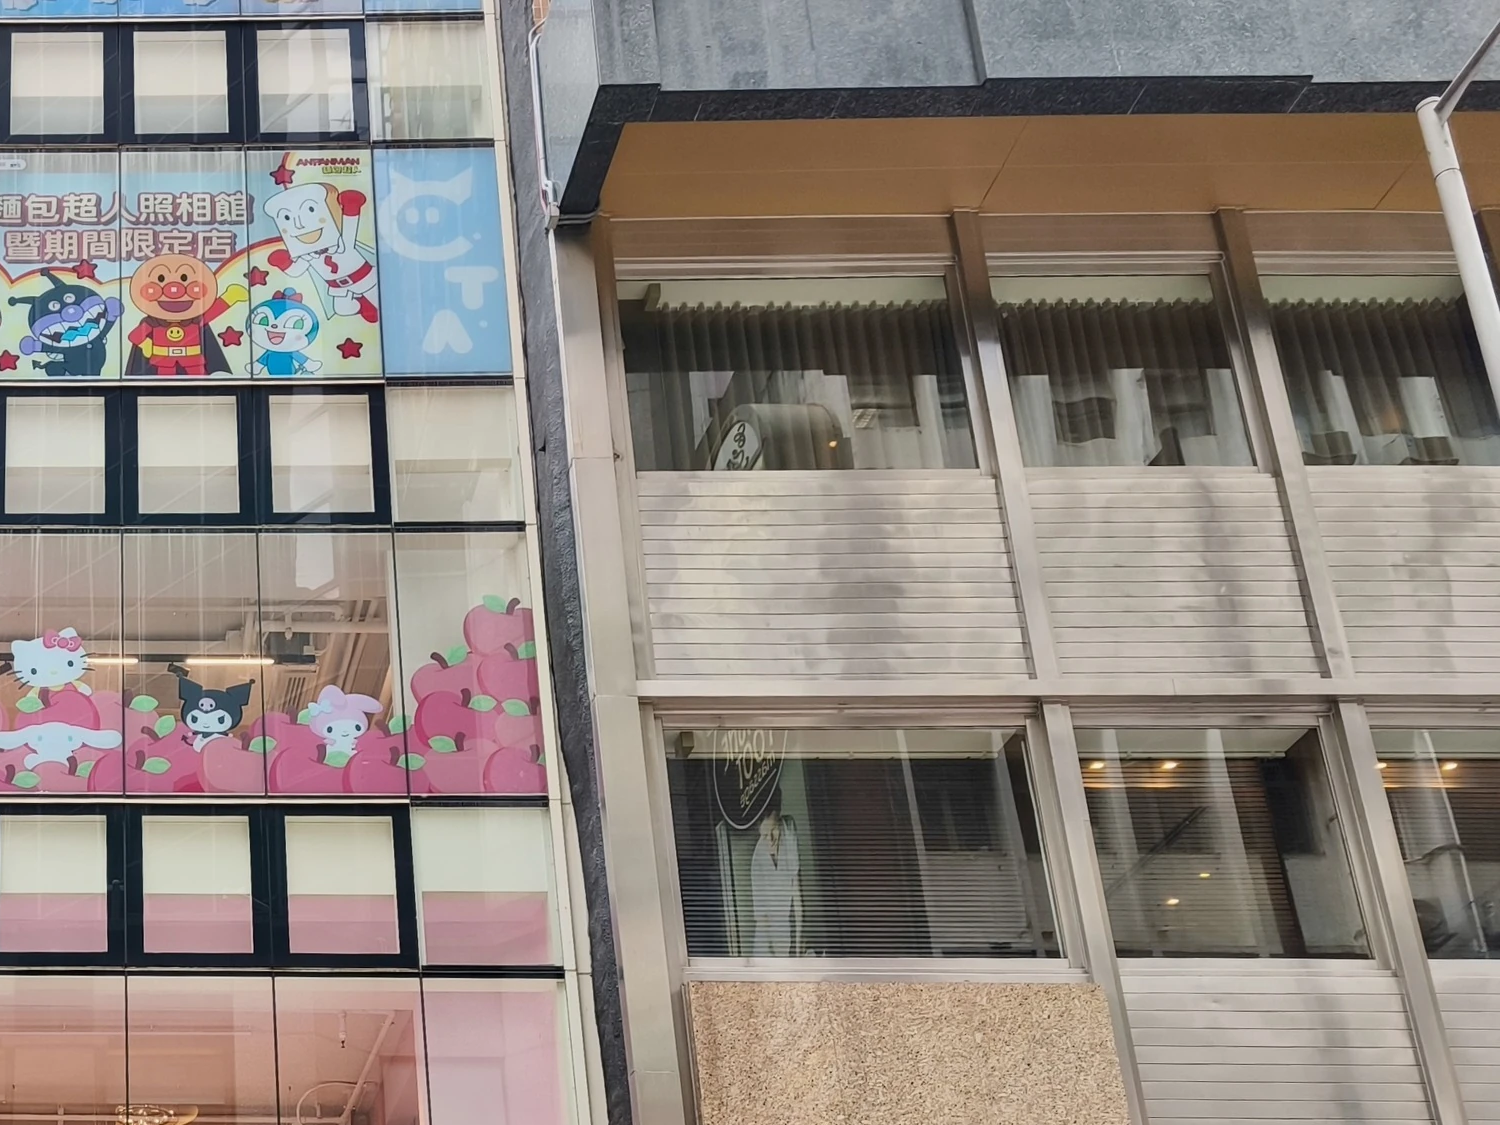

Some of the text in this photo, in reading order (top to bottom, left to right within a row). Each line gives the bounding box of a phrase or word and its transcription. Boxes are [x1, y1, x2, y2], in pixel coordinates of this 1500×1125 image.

[5, 229, 235, 263] 暨期間限定店
